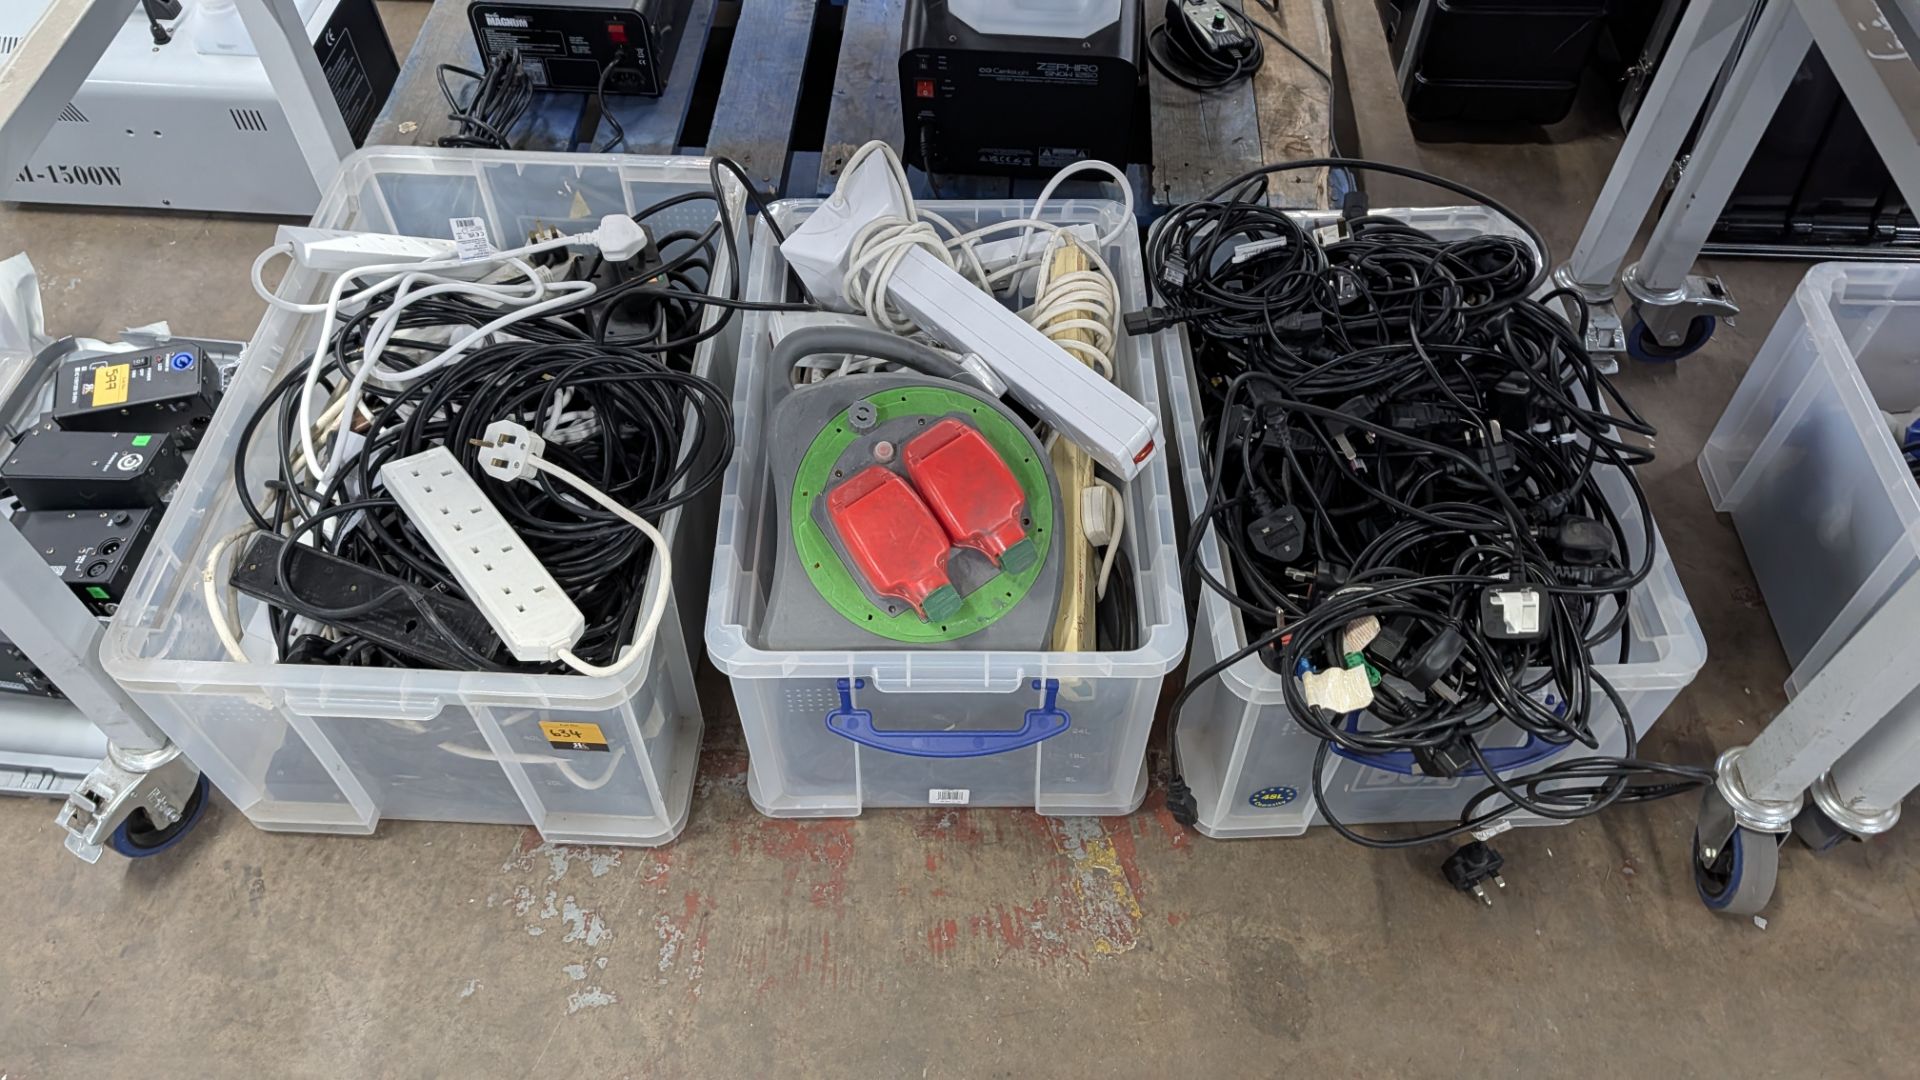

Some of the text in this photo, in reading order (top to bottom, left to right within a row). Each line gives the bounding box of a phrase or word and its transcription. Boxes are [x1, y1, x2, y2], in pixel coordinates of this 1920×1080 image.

[486, 16, 529, 28] MAGNUM
[1036, 62, 1099, 73] ZEPHIRO
[549, 729, 583, 738] 634
